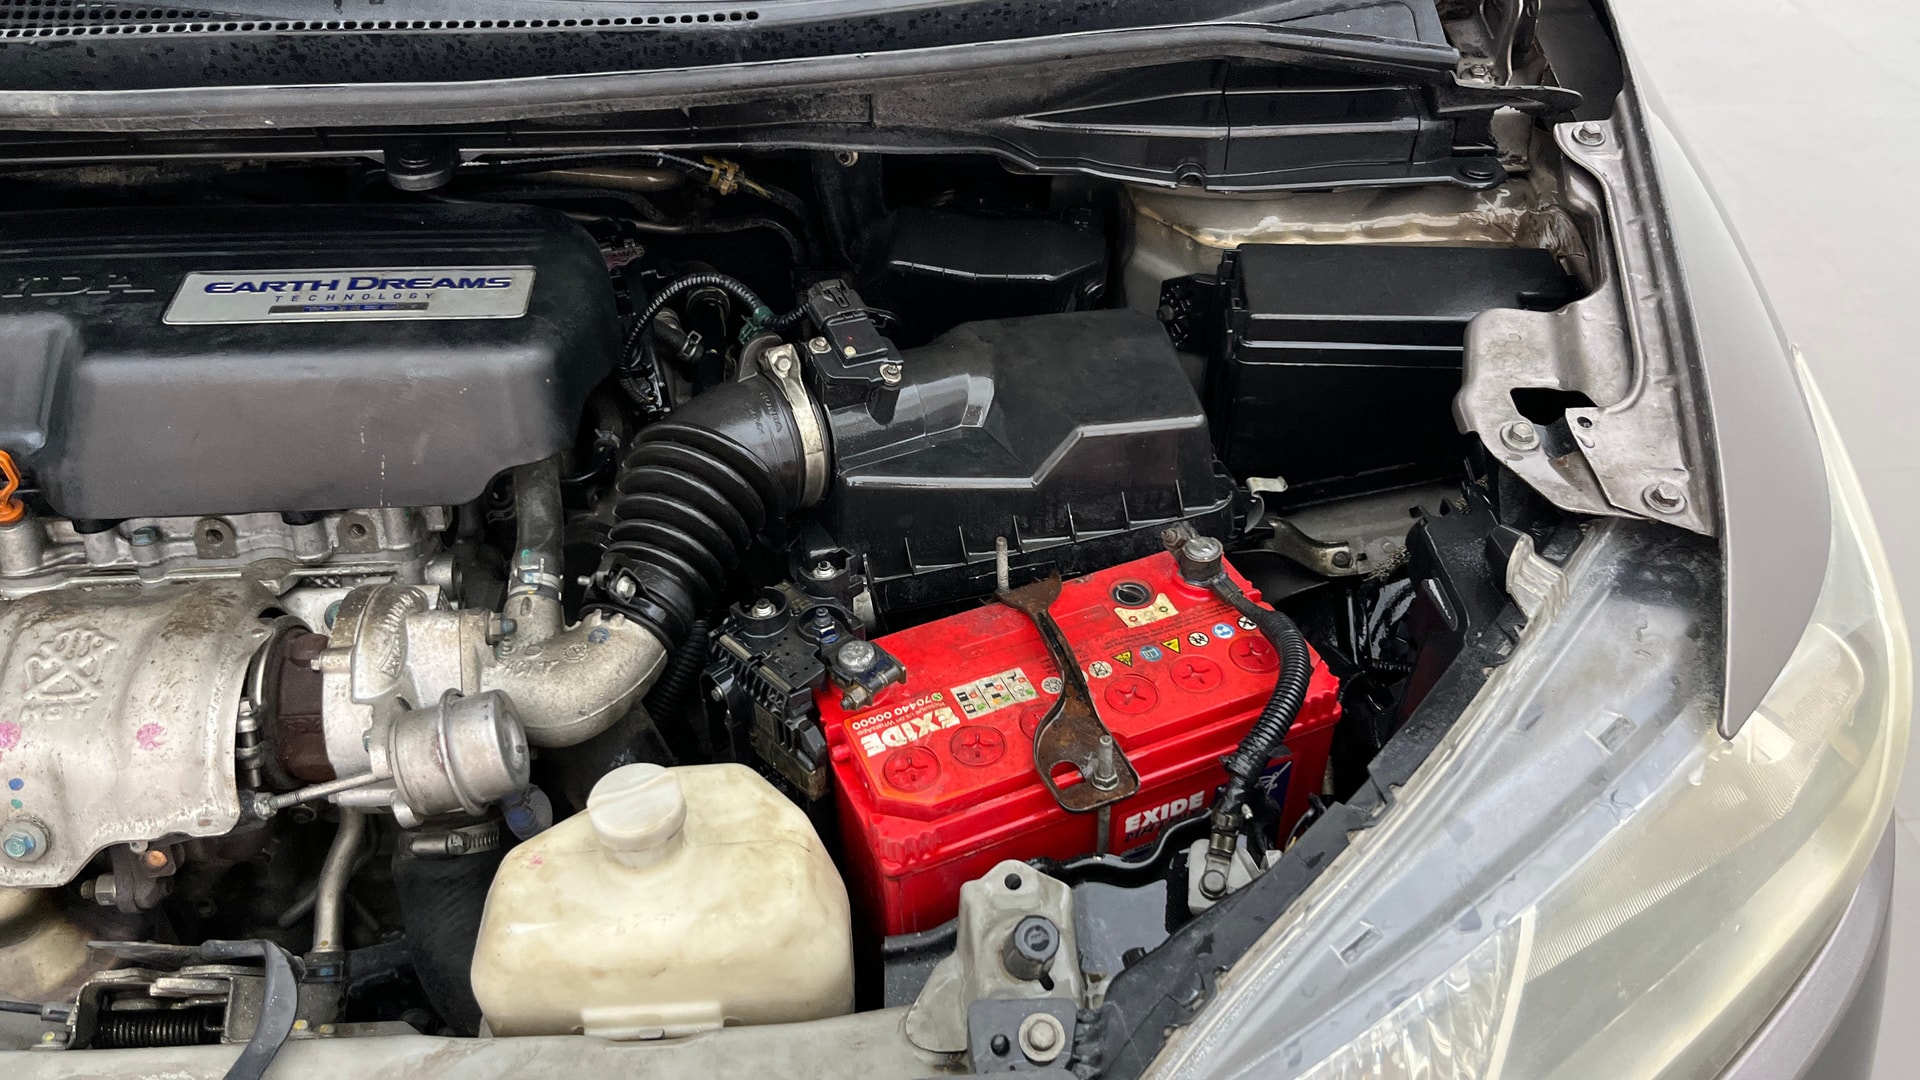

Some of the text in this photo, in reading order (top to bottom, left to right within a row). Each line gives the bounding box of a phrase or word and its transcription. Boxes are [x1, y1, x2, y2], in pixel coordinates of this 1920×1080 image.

[204, 276, 513, 294] EARTH DREAMS
[275, 292, 434, 303] TECHNOLOGY
[852, 695, 932, 730] 70440 00000
[856, 718, 896, 736] WhatsApp
[860, 706, 961, 757] EXIDE
[1125, 790, 1205, 833] EXIDE
